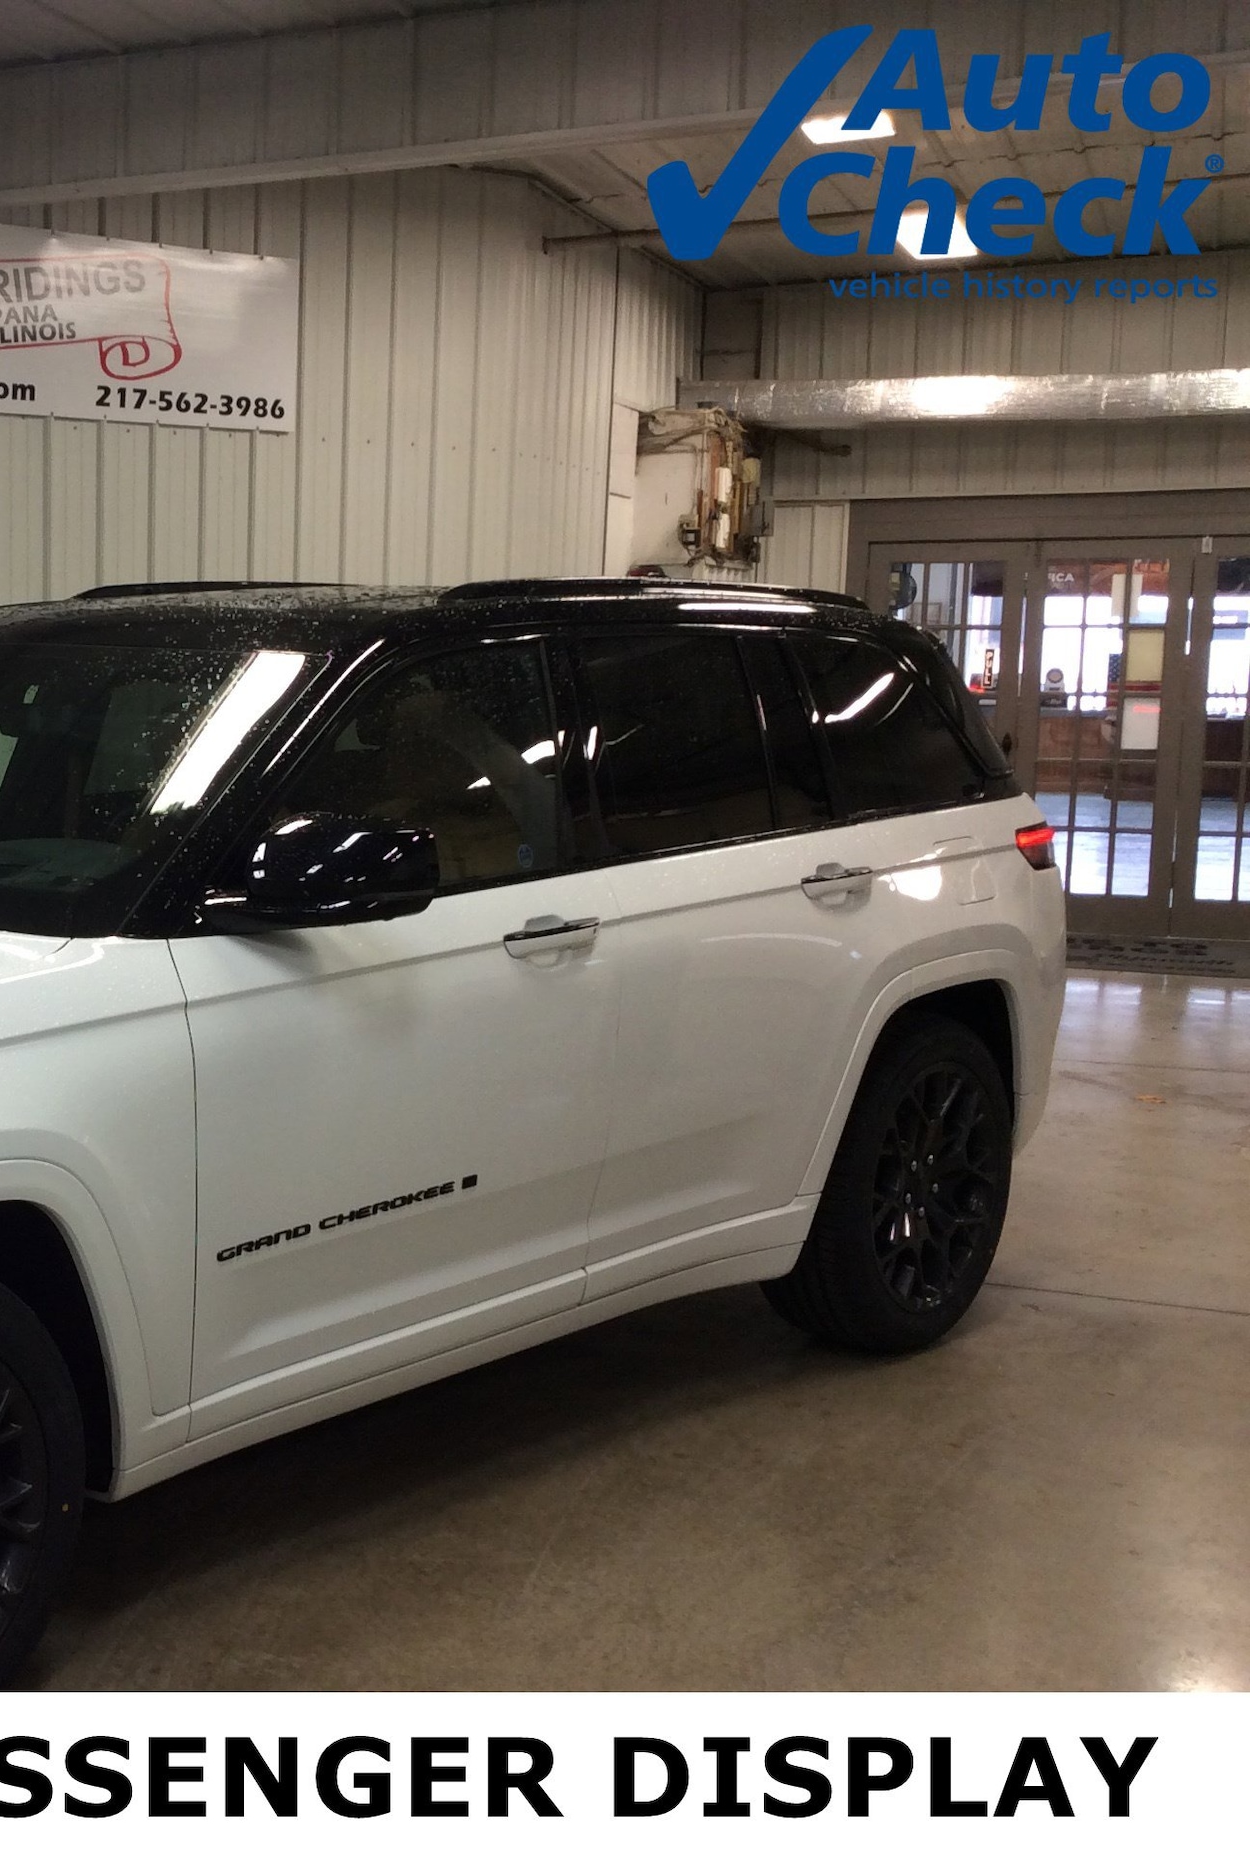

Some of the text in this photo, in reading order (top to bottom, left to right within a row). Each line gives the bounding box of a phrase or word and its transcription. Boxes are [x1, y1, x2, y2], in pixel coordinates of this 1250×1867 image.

[95, 385, 285, 420] 217-562-3986
[983, 651, 994, 685] PULL
[216, 1181, 456, 1262] GRAND CHEROKEE
